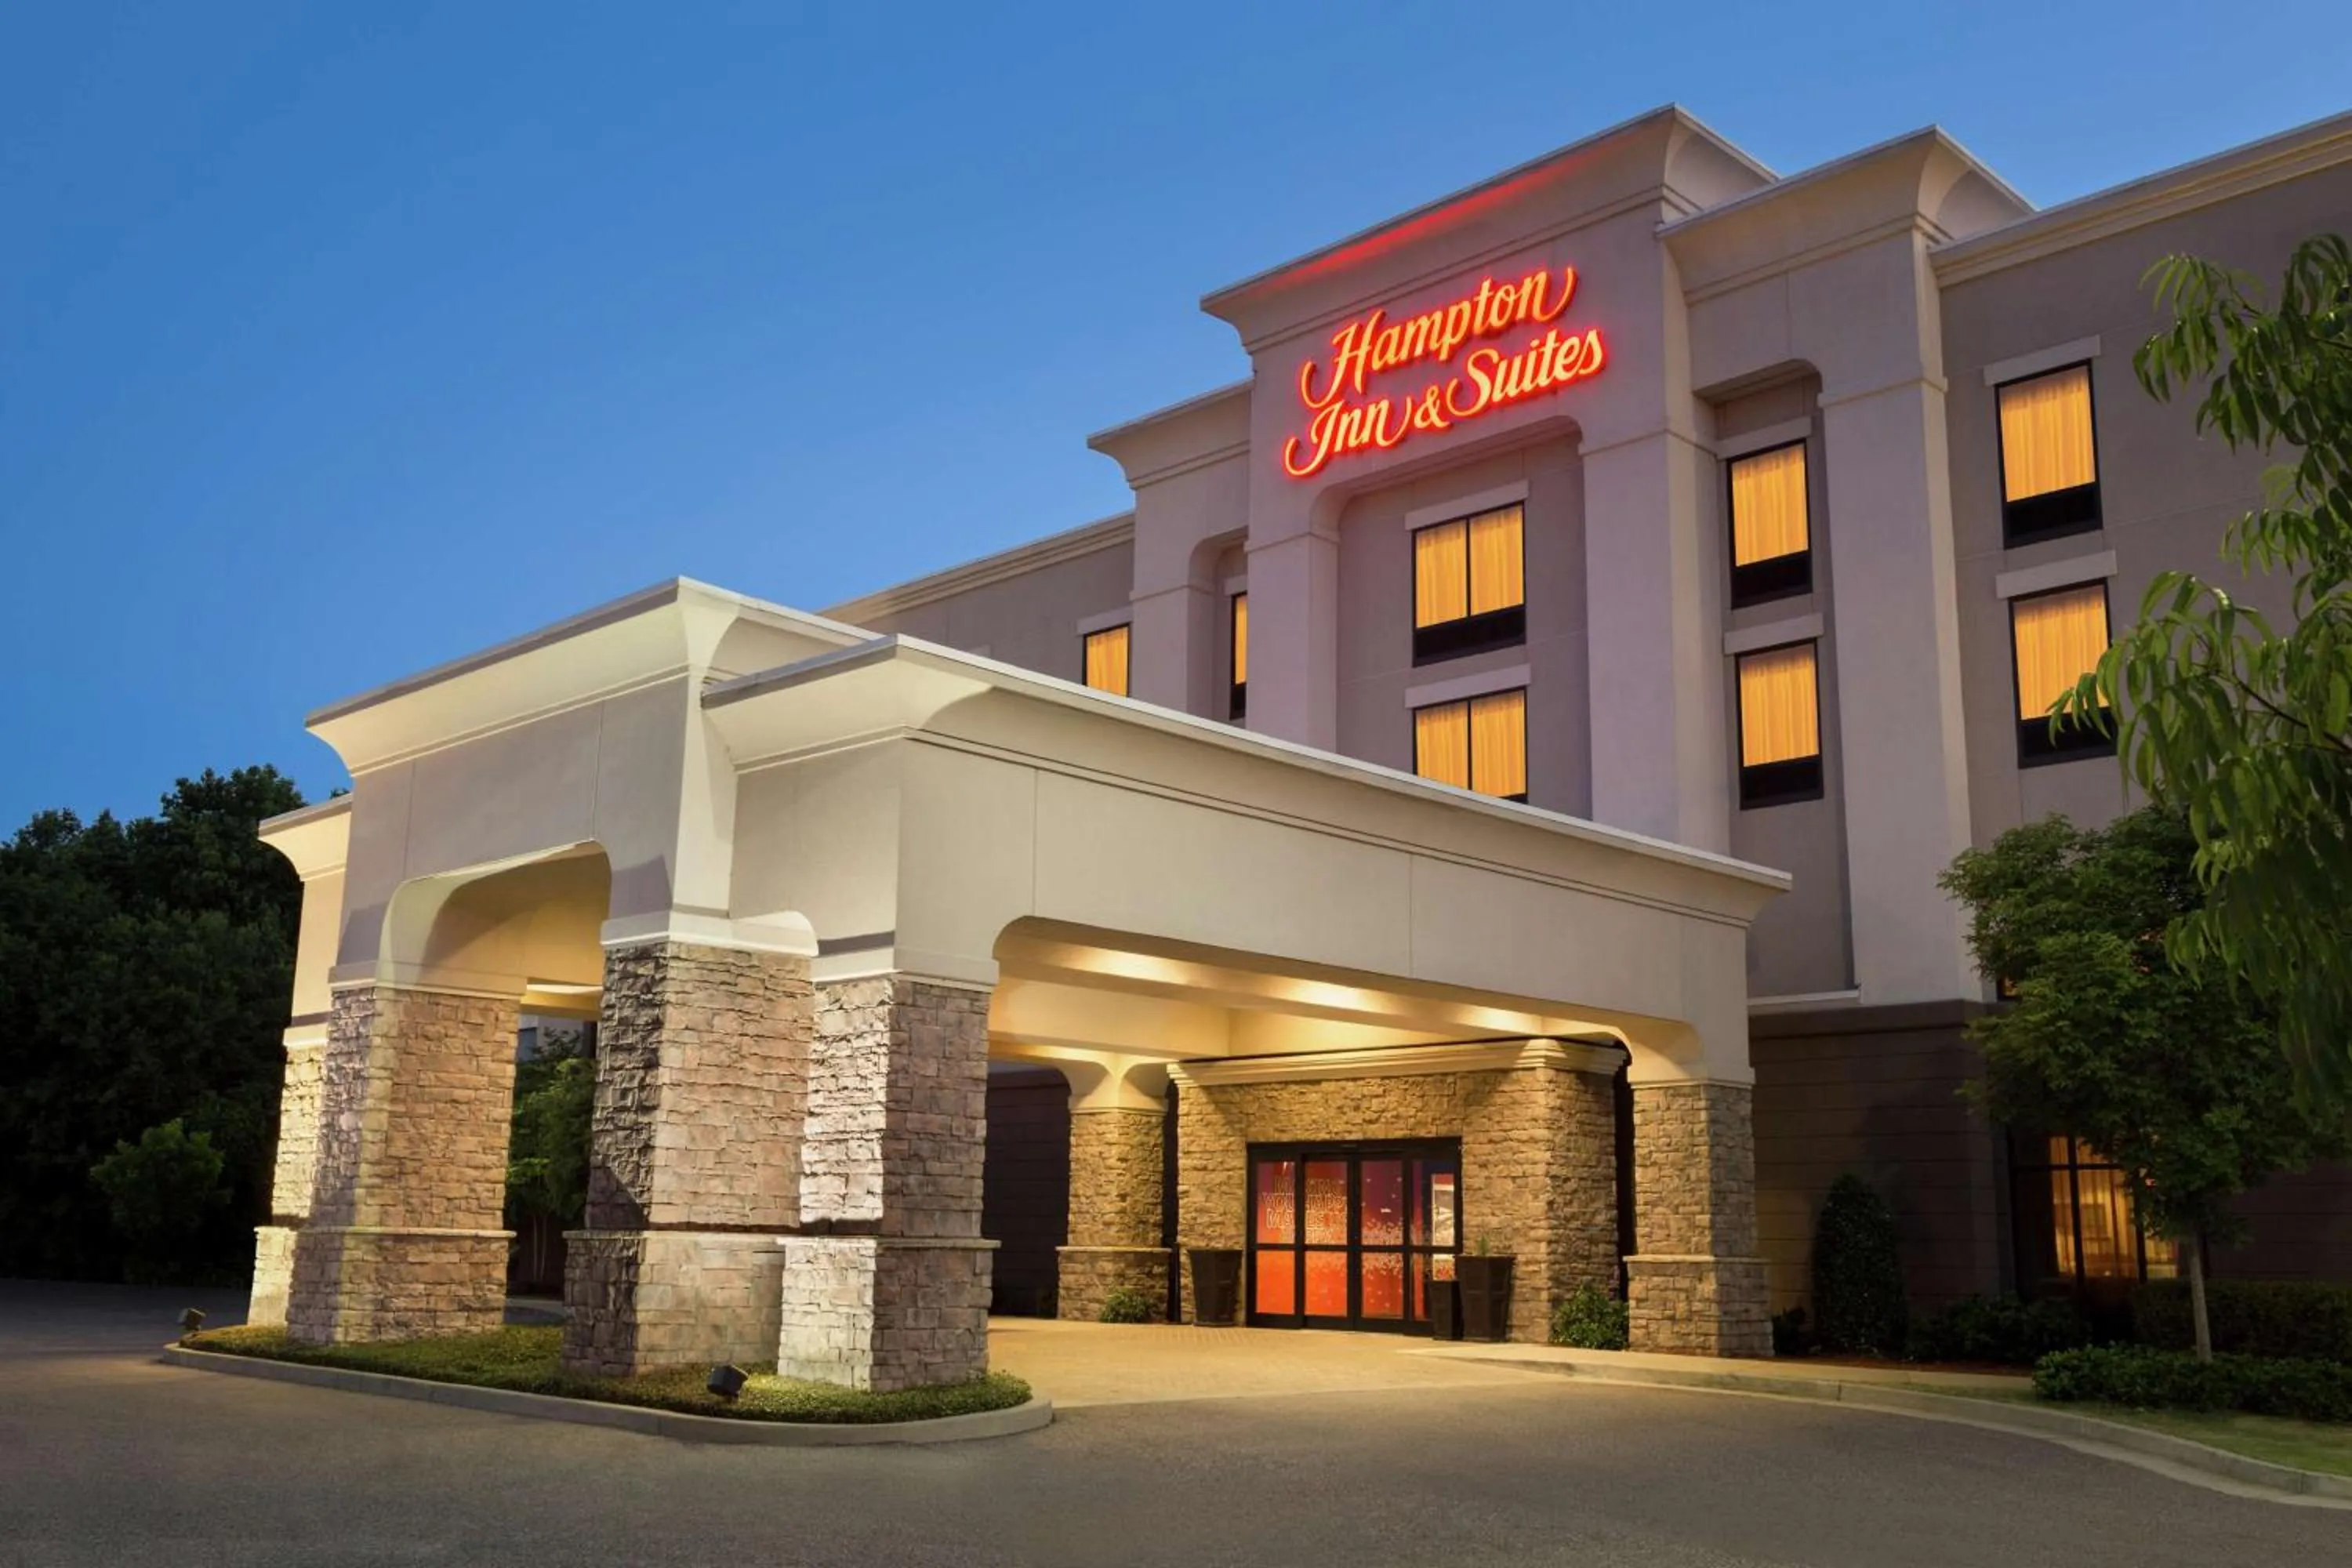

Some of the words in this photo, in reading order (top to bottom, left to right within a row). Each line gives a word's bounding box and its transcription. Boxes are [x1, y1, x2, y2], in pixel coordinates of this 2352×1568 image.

[1284, 396, 1413, 477] Inn
[1414, 384, 1450, 430] &
[1446, 327, 1604, 418] Suites
[1301, 265, 1577, 408] Hampton
